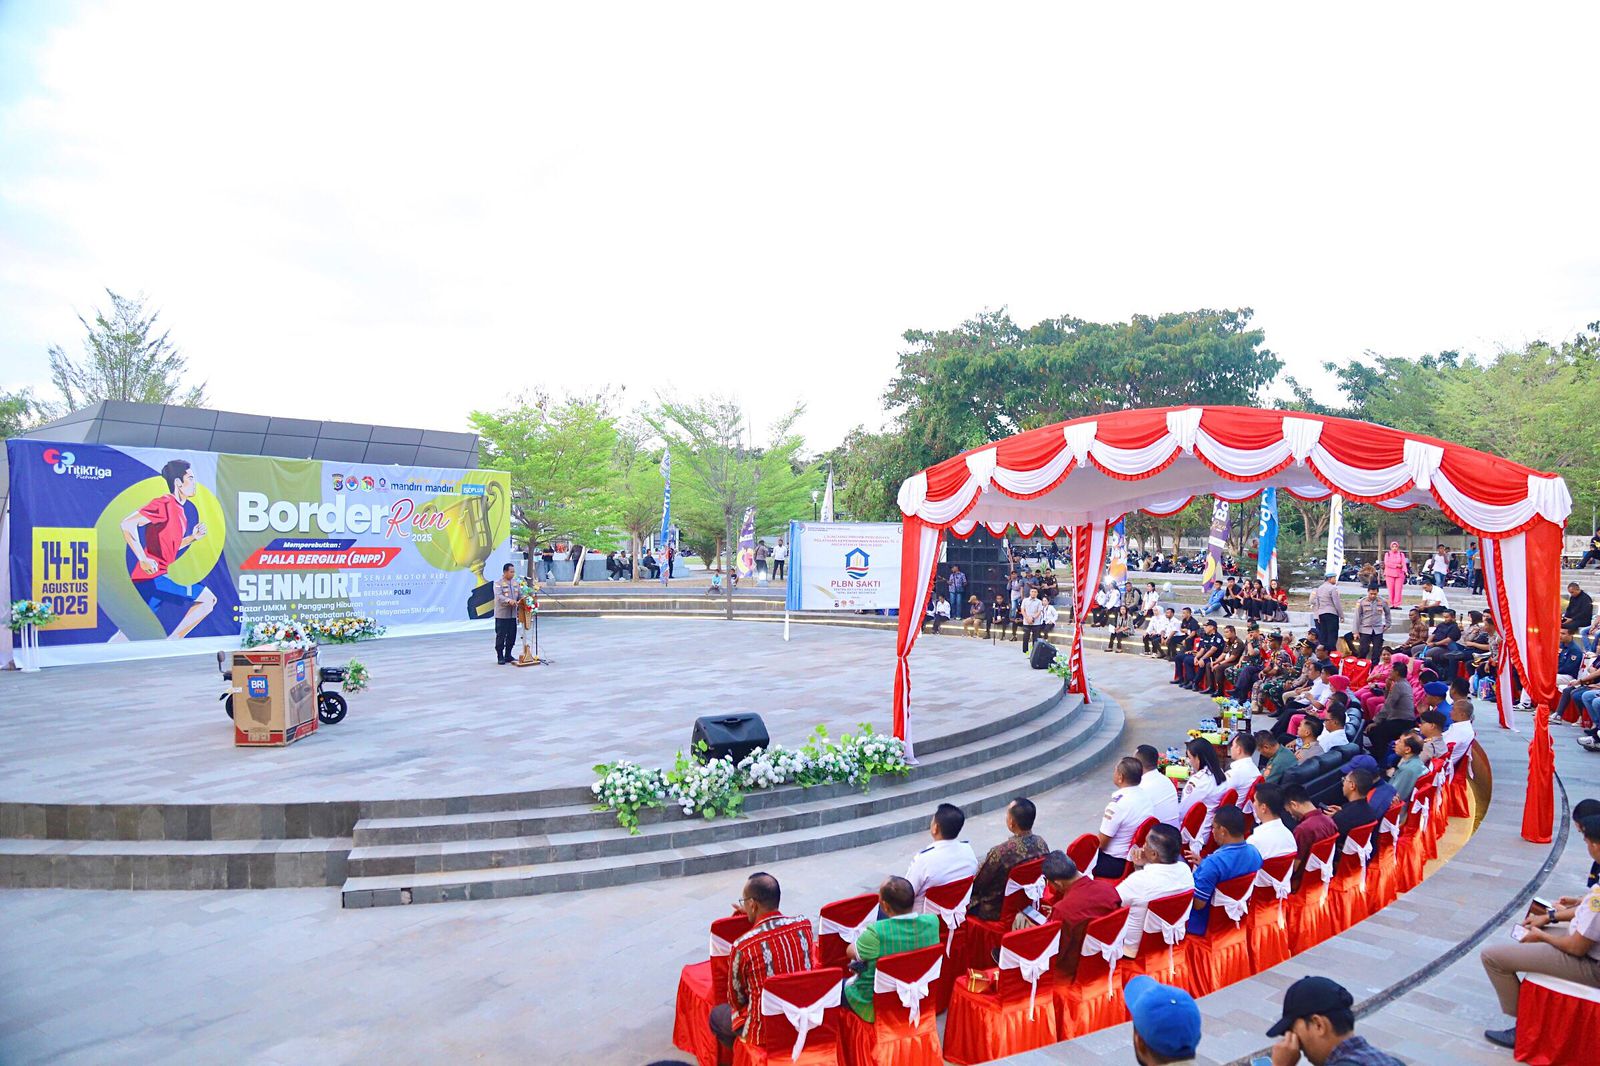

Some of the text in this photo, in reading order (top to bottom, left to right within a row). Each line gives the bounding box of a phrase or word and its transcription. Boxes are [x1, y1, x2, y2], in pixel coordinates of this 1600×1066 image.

[66, 465, 112, 479] TitikTiga
[390, 482, 422, 492] mandiri
[425, 483, 454, 493] mandiri
[238, 491, 450, 539] Border Run
[411, 534, 432, 543] 2025
[41, 541, 88, 581] 14-15
[259, 551, 386, 566] PIALA BERGILIR (BNPP)
[42, 582, 88, 594] AGUSTUS
[238, 572, 362, 602] SENMORI
[831, 580, 881, 588] PLBN SAKTI
[239, 604, 287, 613] Bazar UMKM
[297, 601, 363, 612] Panggung Hiburan
[300, 611, 345, 620] Pengobatan
[375, 608, 410, 617] Pelayanan
[239, 615, 263, 623] Donor
[251, 680, 266, 689] BRI
